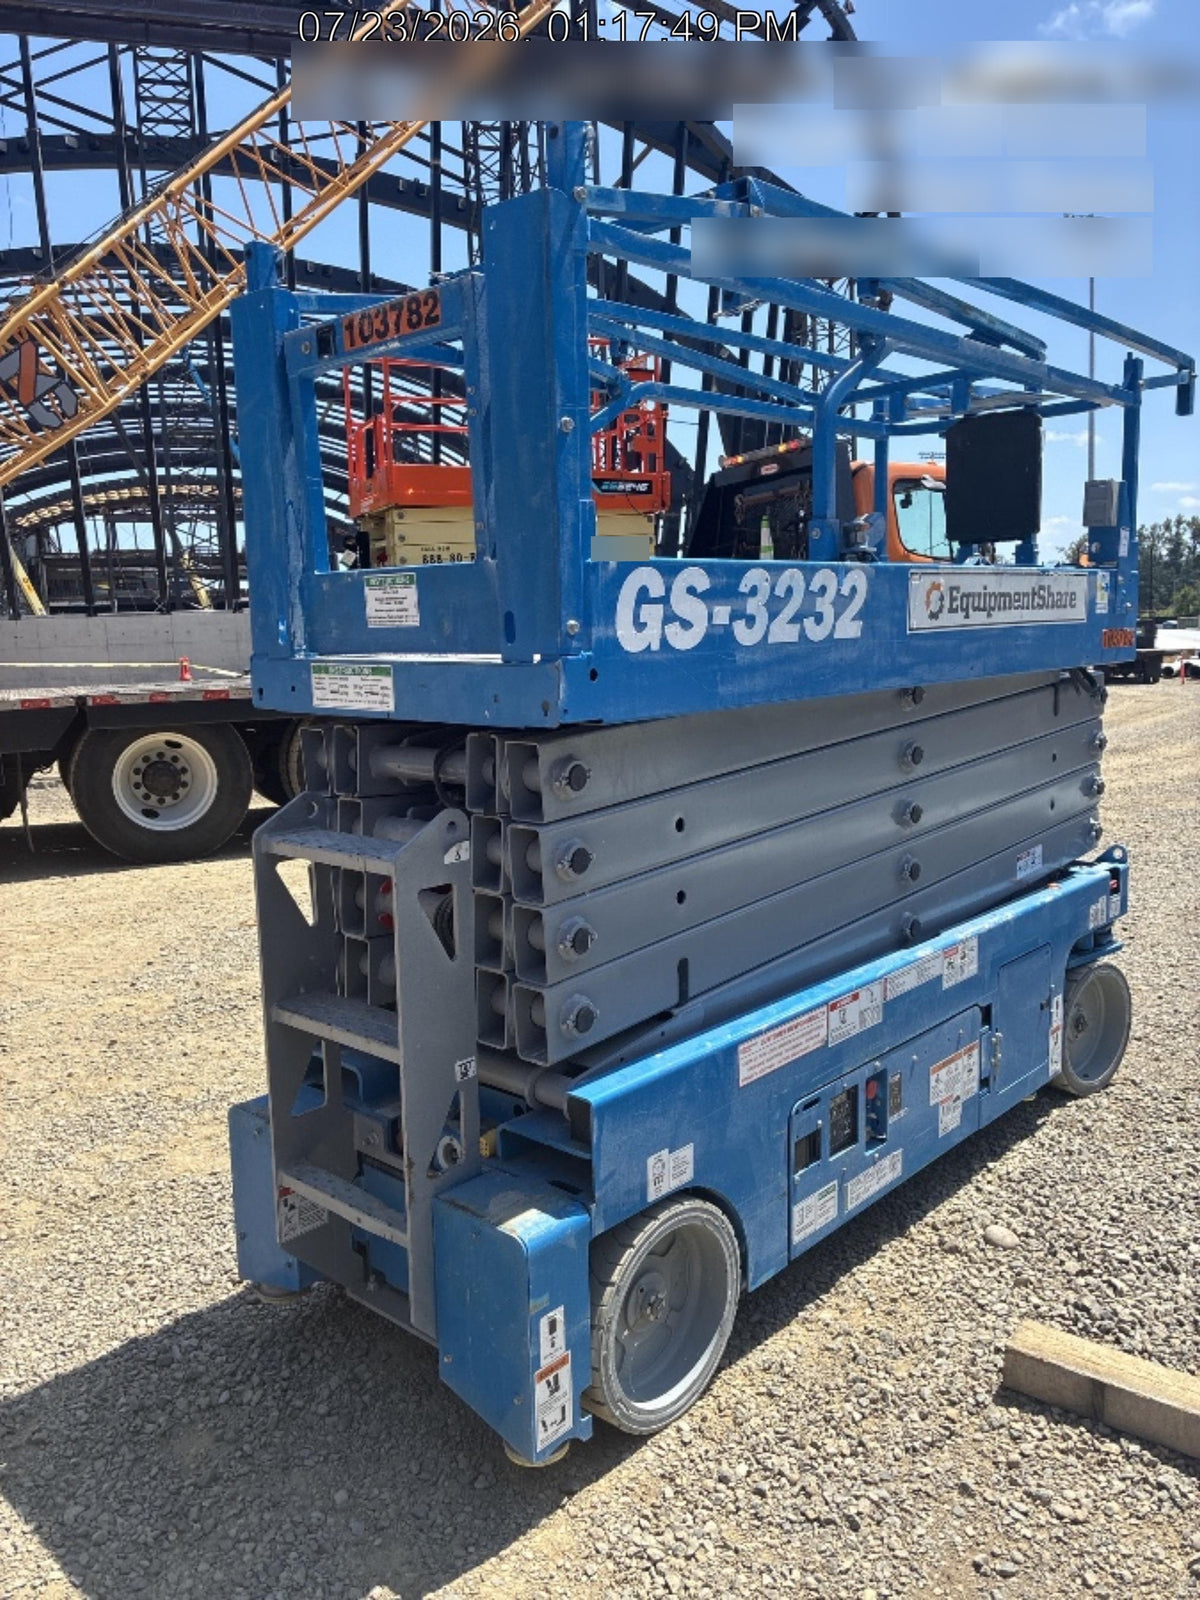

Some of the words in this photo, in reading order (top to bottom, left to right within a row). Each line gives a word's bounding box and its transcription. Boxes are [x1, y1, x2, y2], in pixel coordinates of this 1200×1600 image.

[344, 291, 440, 347] 103782
[615, 566, 868, 653] GS-3232
[947, 585, 1077, 619] EquipmentShare
